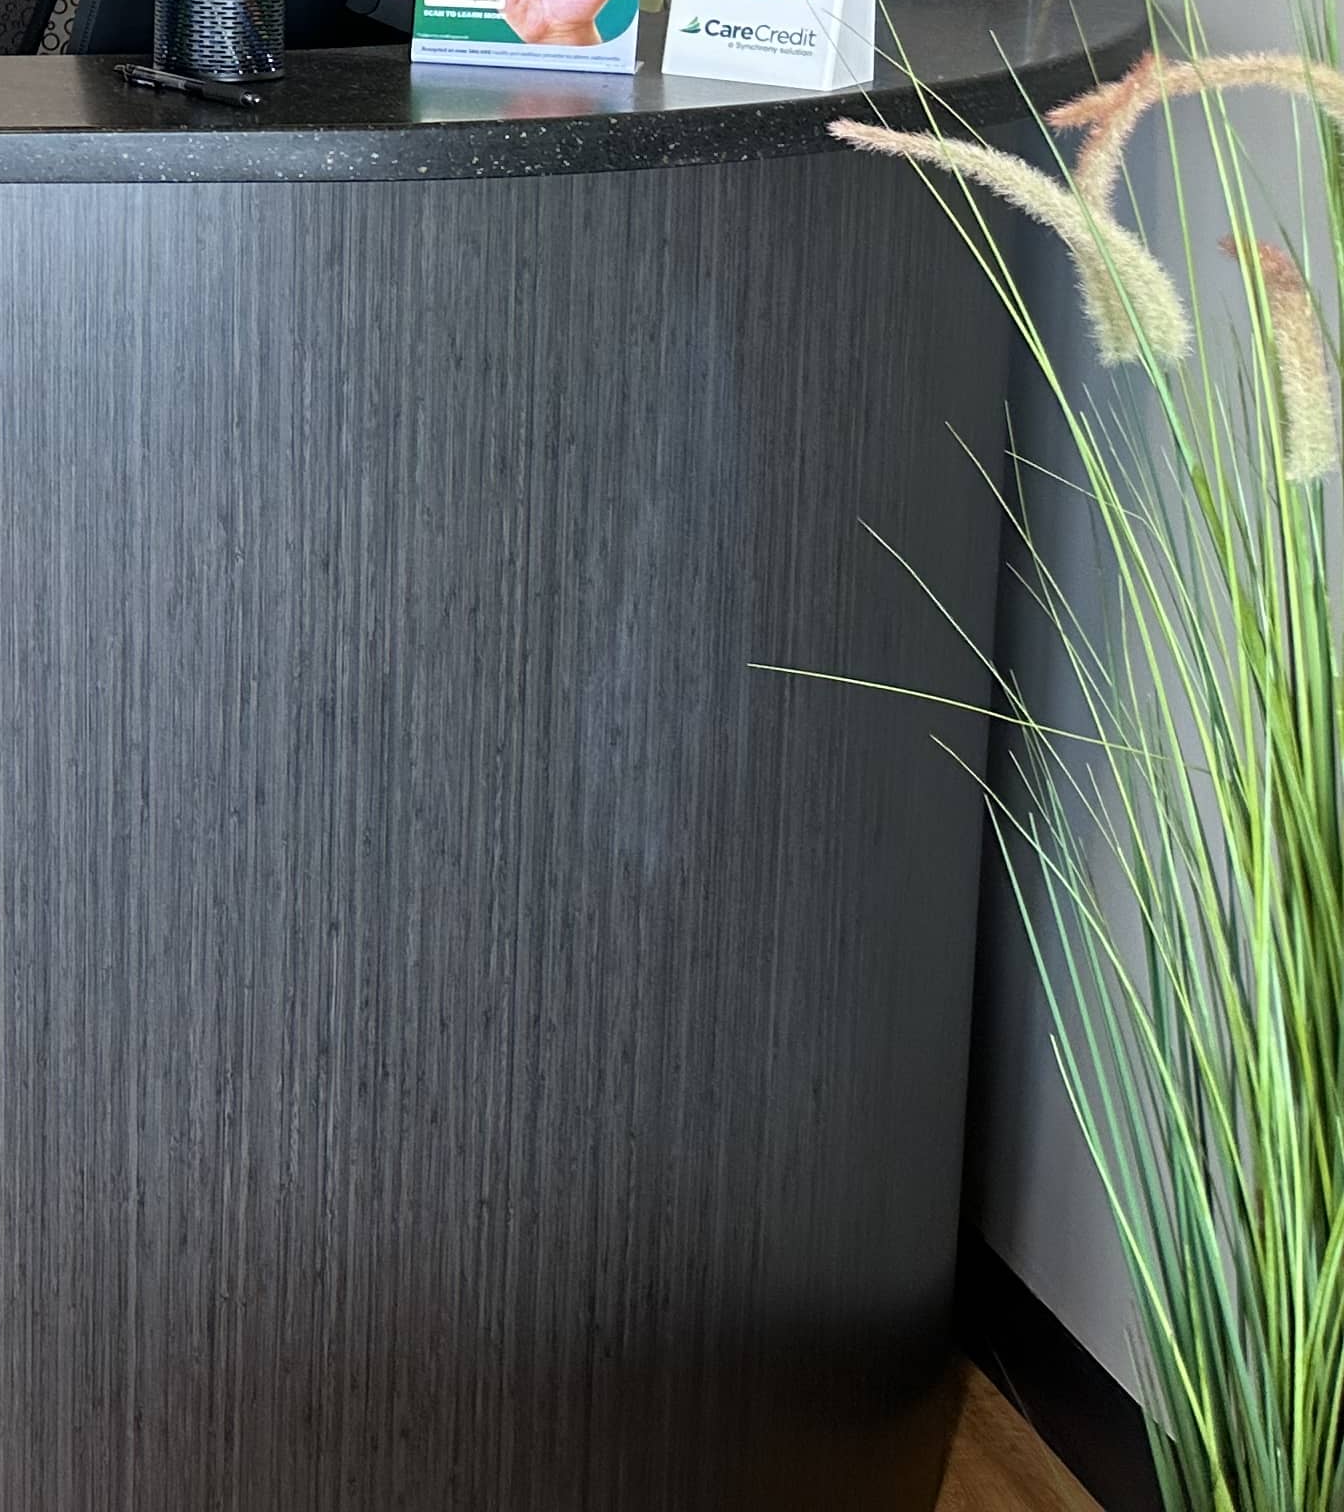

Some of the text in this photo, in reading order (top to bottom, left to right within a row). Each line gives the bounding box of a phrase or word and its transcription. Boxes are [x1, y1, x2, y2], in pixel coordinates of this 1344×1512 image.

[705, 19, 816, 47] CareCredit
[736, 41, 777, 54] Synchrony
[780, 48, 813, 57] solution
